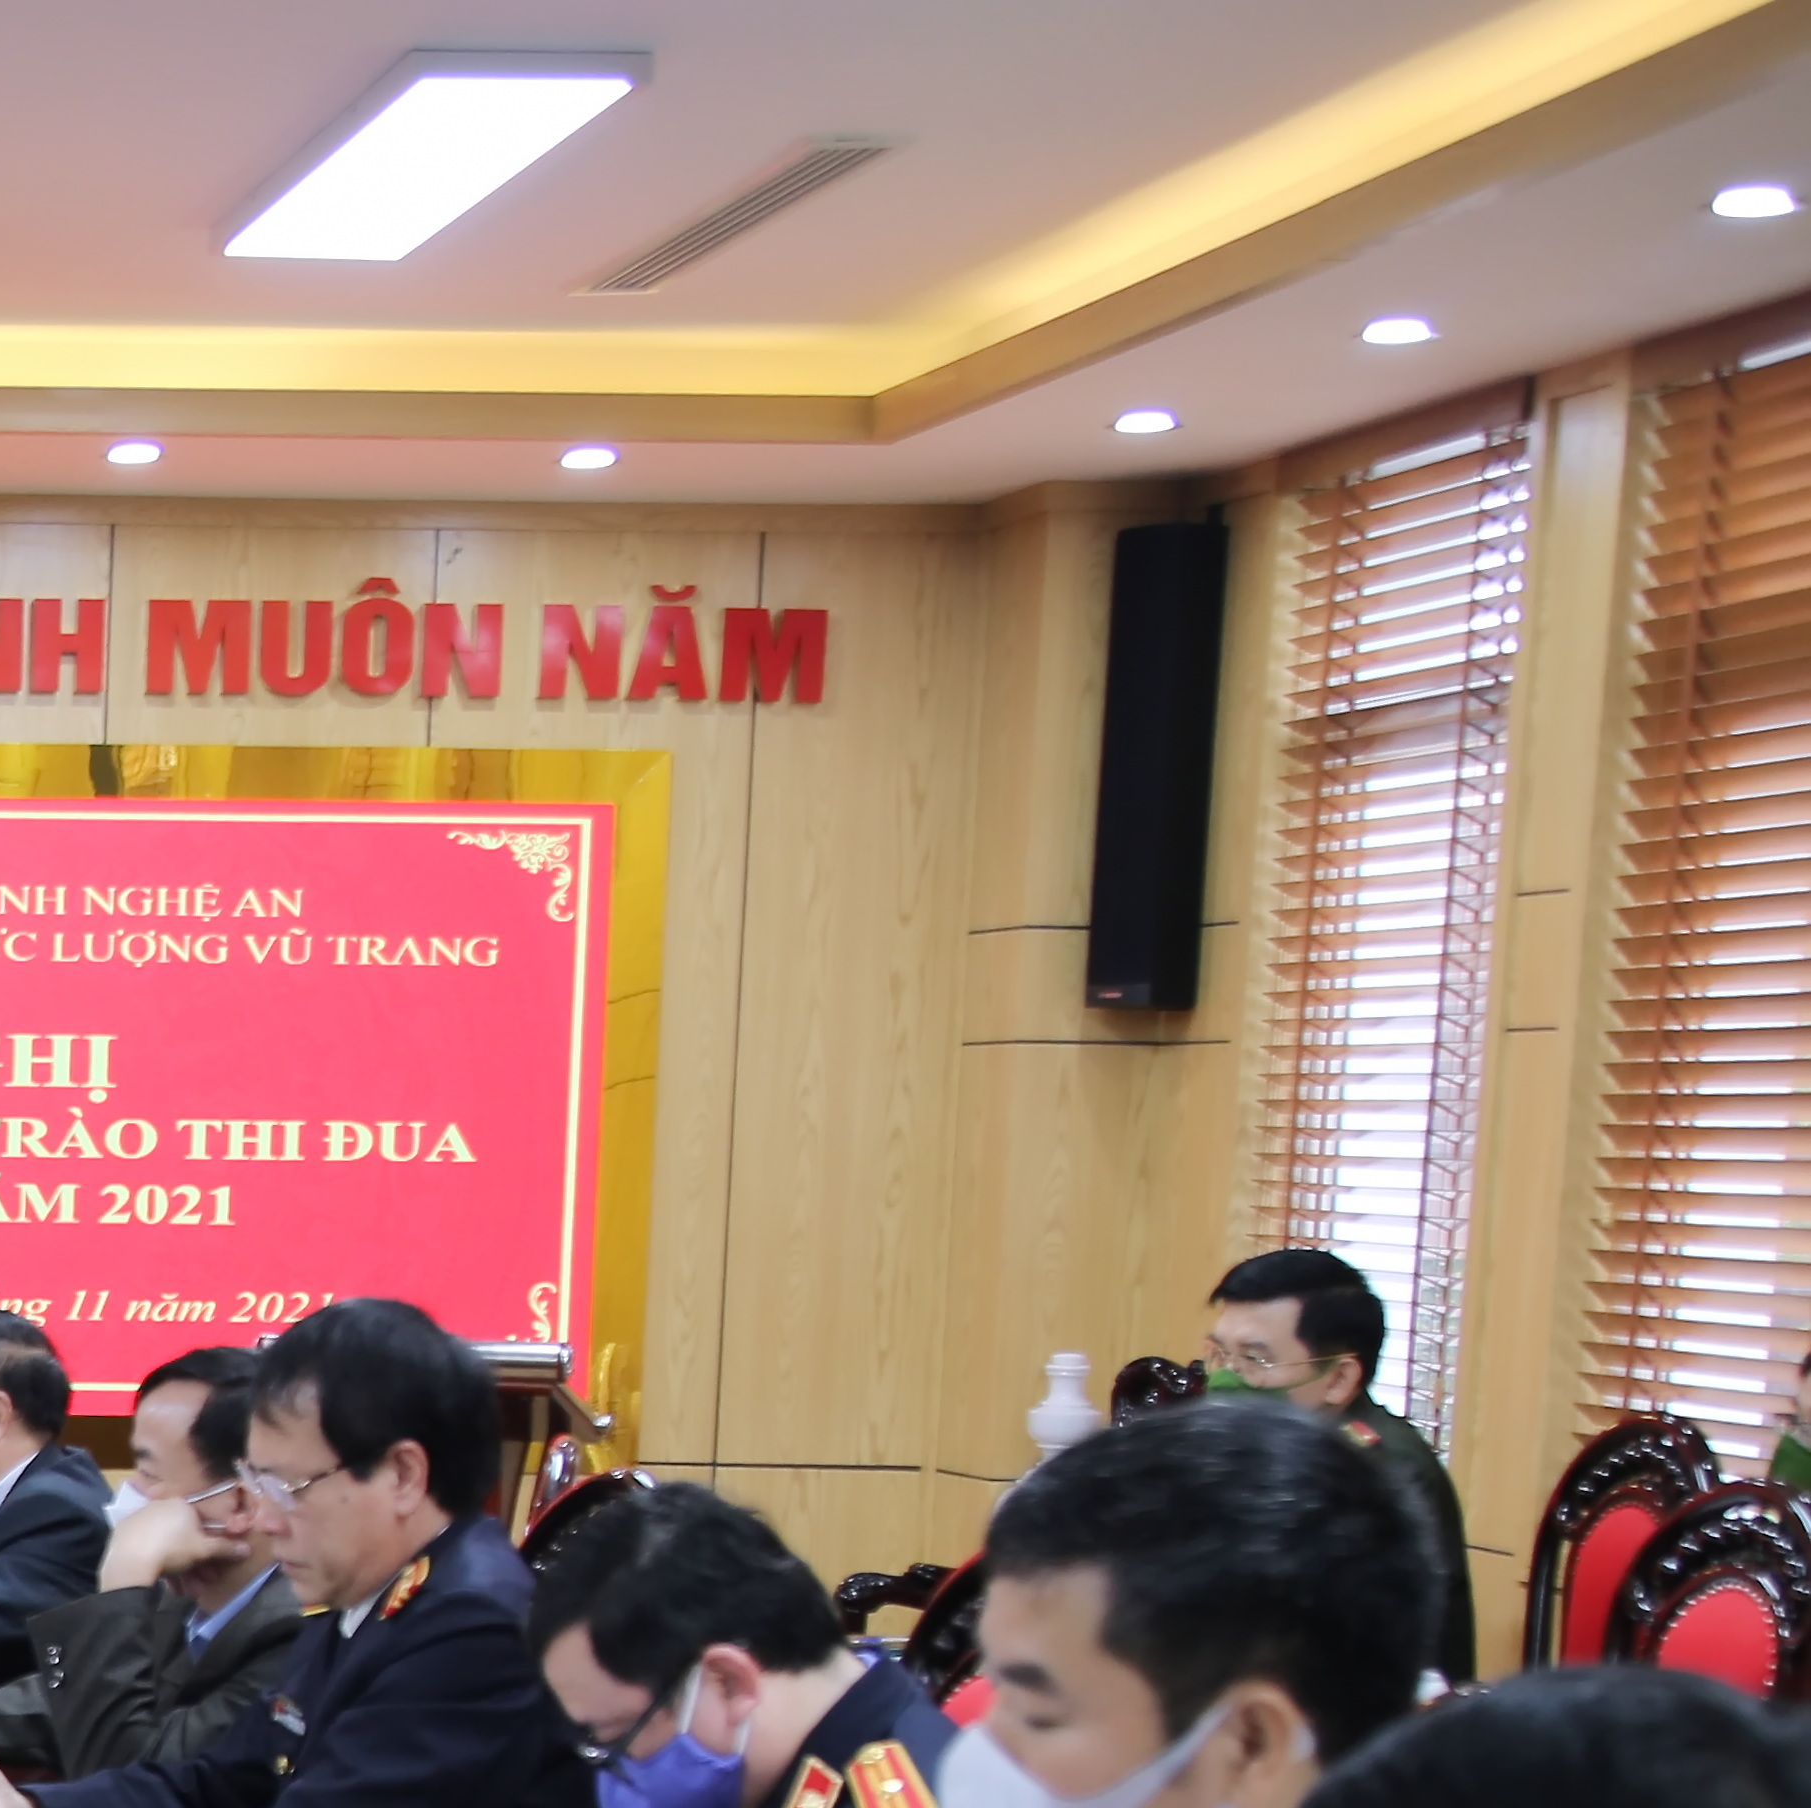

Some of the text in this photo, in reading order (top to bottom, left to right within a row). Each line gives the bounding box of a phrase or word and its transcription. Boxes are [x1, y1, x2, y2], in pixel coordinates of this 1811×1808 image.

[147, 577, 503, 699] MUÔN
[540, 585, 827, 703] NĂM
[82, 883, 222, 922] NGHỆ
[232, 888, 303, 919] AN
[51, 931, 229, 968] LƯỢNG
[245, 929, 313, 966] VŨ
[326, 936, 499, 967] TRANG
[175, 1119, 306, 1161] THI
[323, 1120, 477, 1163] ĐUA
[98, 1183, 235, 1226] 2021
[65, 1290, 110, 1321] 11
[124, 1292, 216, 1322] năm
